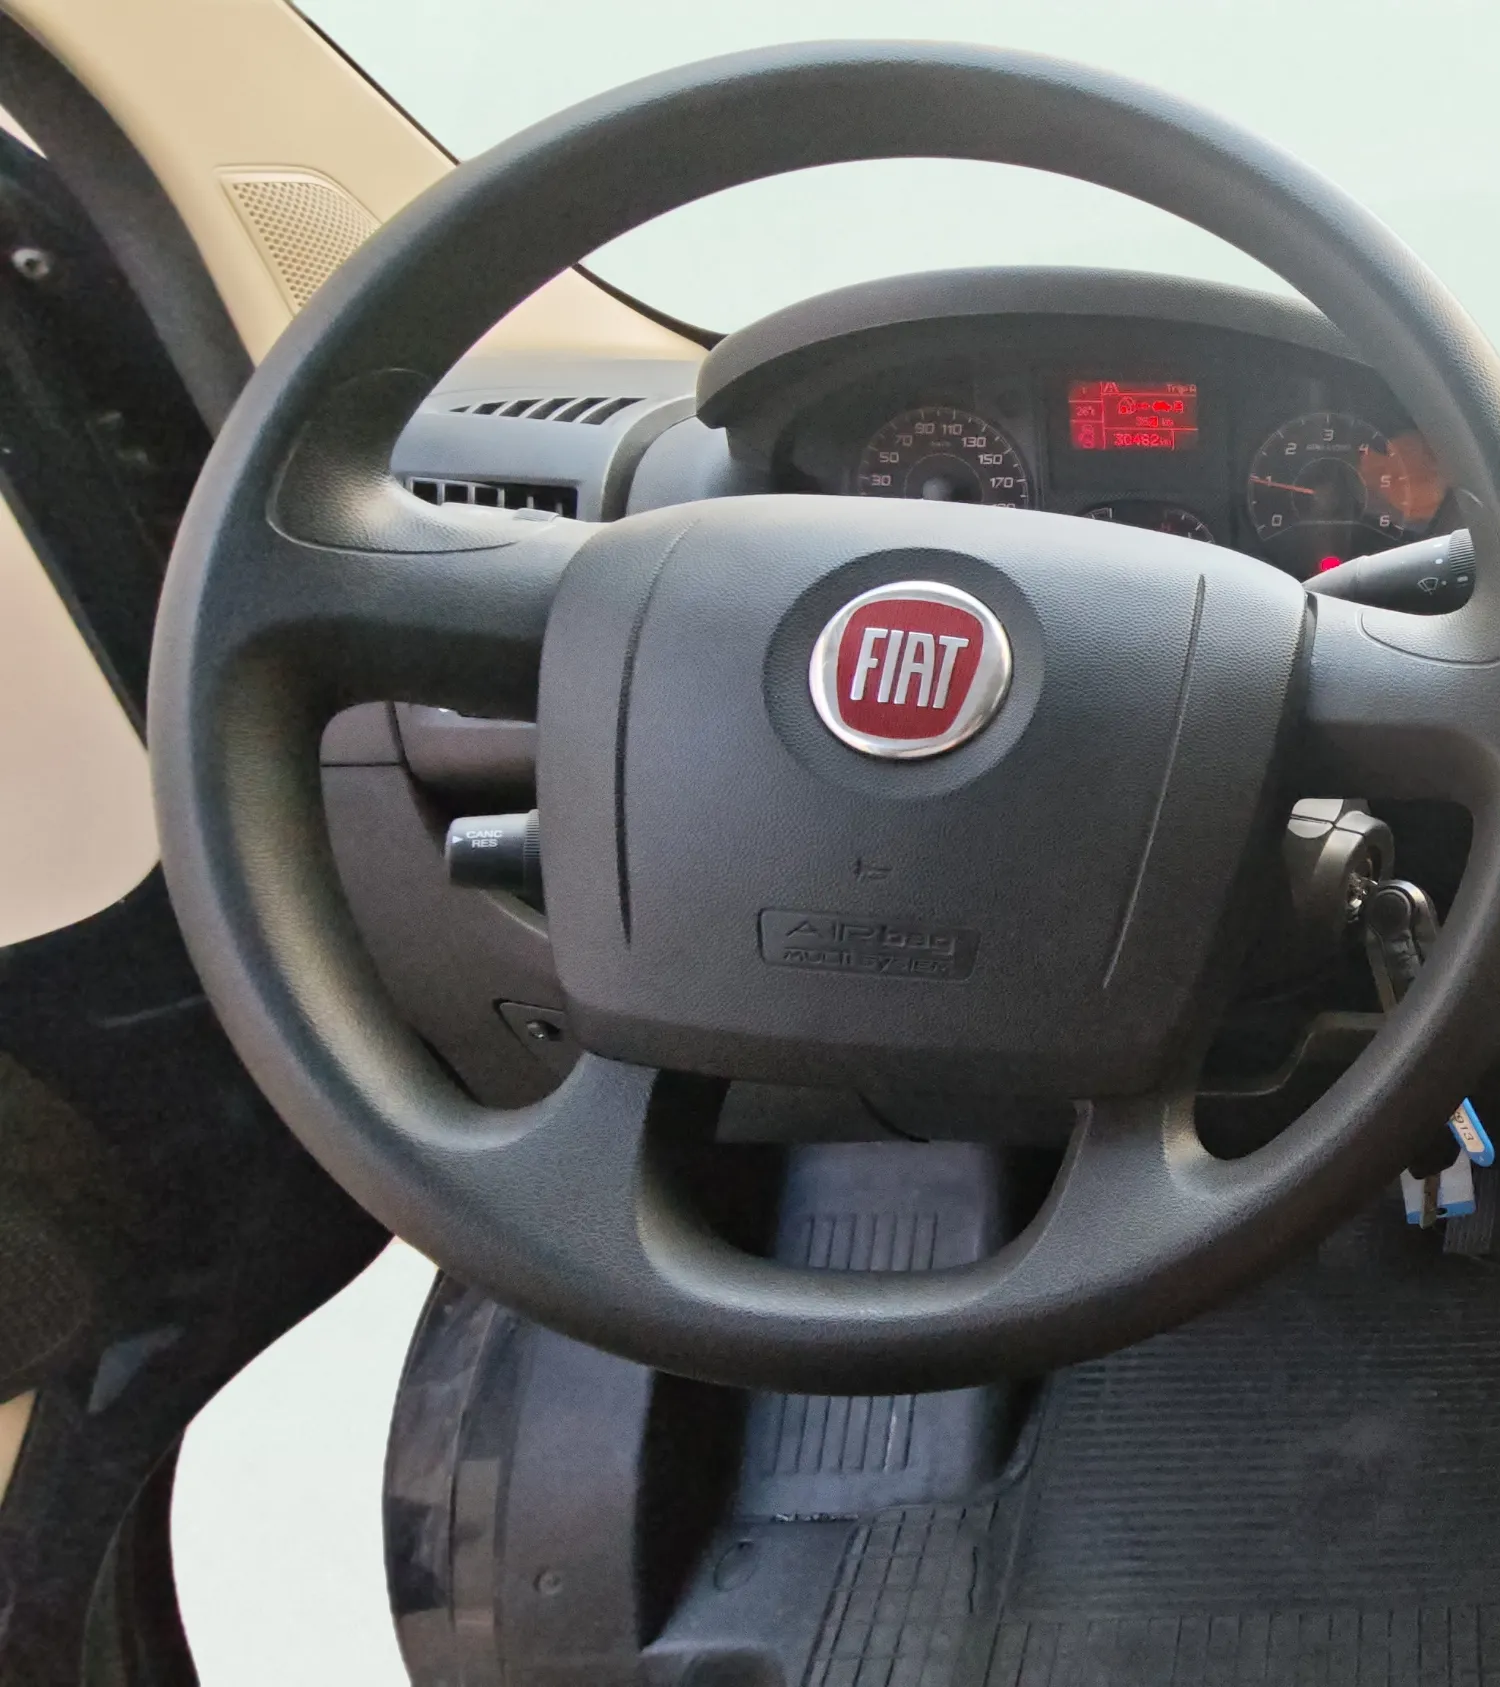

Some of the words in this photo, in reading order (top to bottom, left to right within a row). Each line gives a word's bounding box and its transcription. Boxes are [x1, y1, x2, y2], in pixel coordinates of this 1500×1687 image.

[915, 422, 935, 435] 90
[941, 423, 963, 436] 110
[896, 434, 913, 446] 70
[1322, 429, 1334, 442] 3
[961, 437, 987, 448] 130
[1284, 442, 1297, 455] 2
[1358, 443, 1370, 456] 4
[879, 452, 900, 463] 50
[978, 454, 1003, 465] 150
[871, 475, 892, 487] 30
[990, 476, 1014, 488] 170
[1380, 475, 1391, 488] 5
[1271, 514, 1283, 527] 0
[1379, 515, 1391, 527] 6
[850, 627, 969, 709] FIAT
[466, 830, 503, 839] CANC
[471, 839, 499, 848] RES
